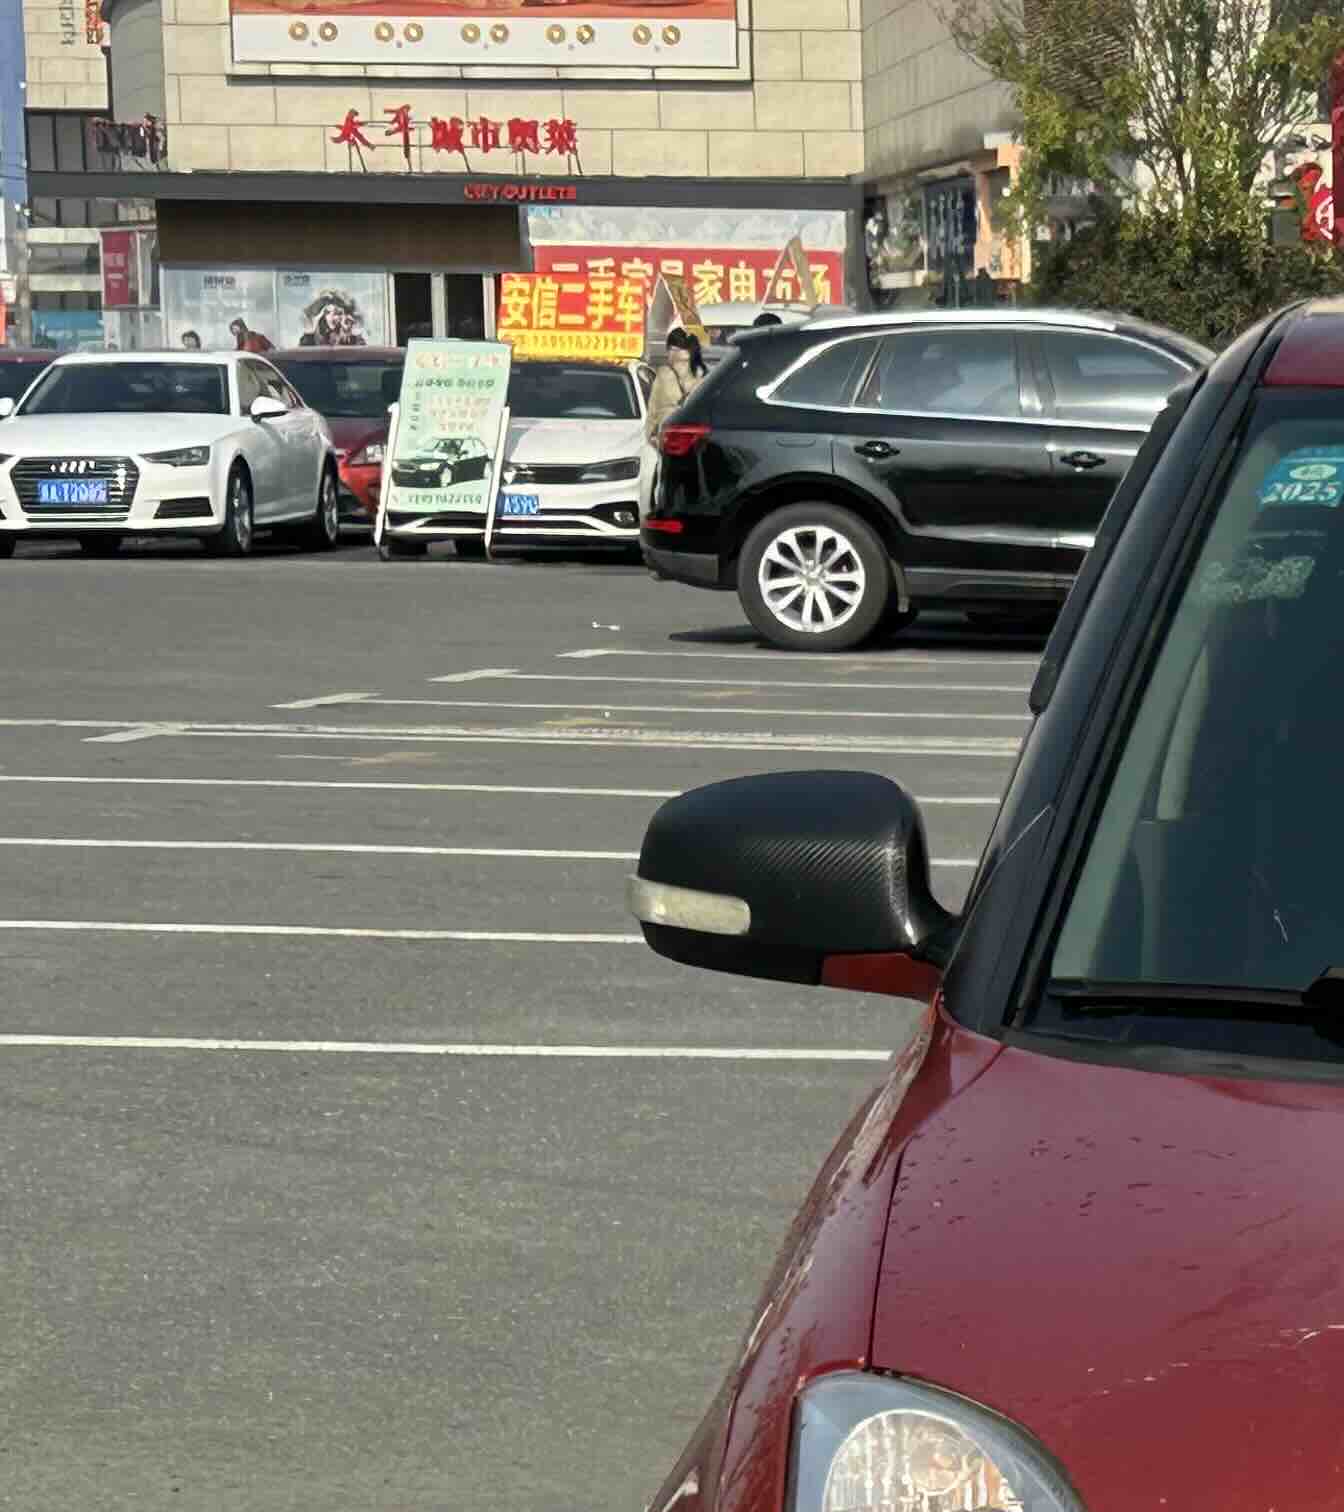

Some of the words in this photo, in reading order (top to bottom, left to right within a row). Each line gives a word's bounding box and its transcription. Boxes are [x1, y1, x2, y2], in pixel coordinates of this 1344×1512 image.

[502, 277, 644, 332] 安信二手车
[1260, 481, 1340, 503] 2025
